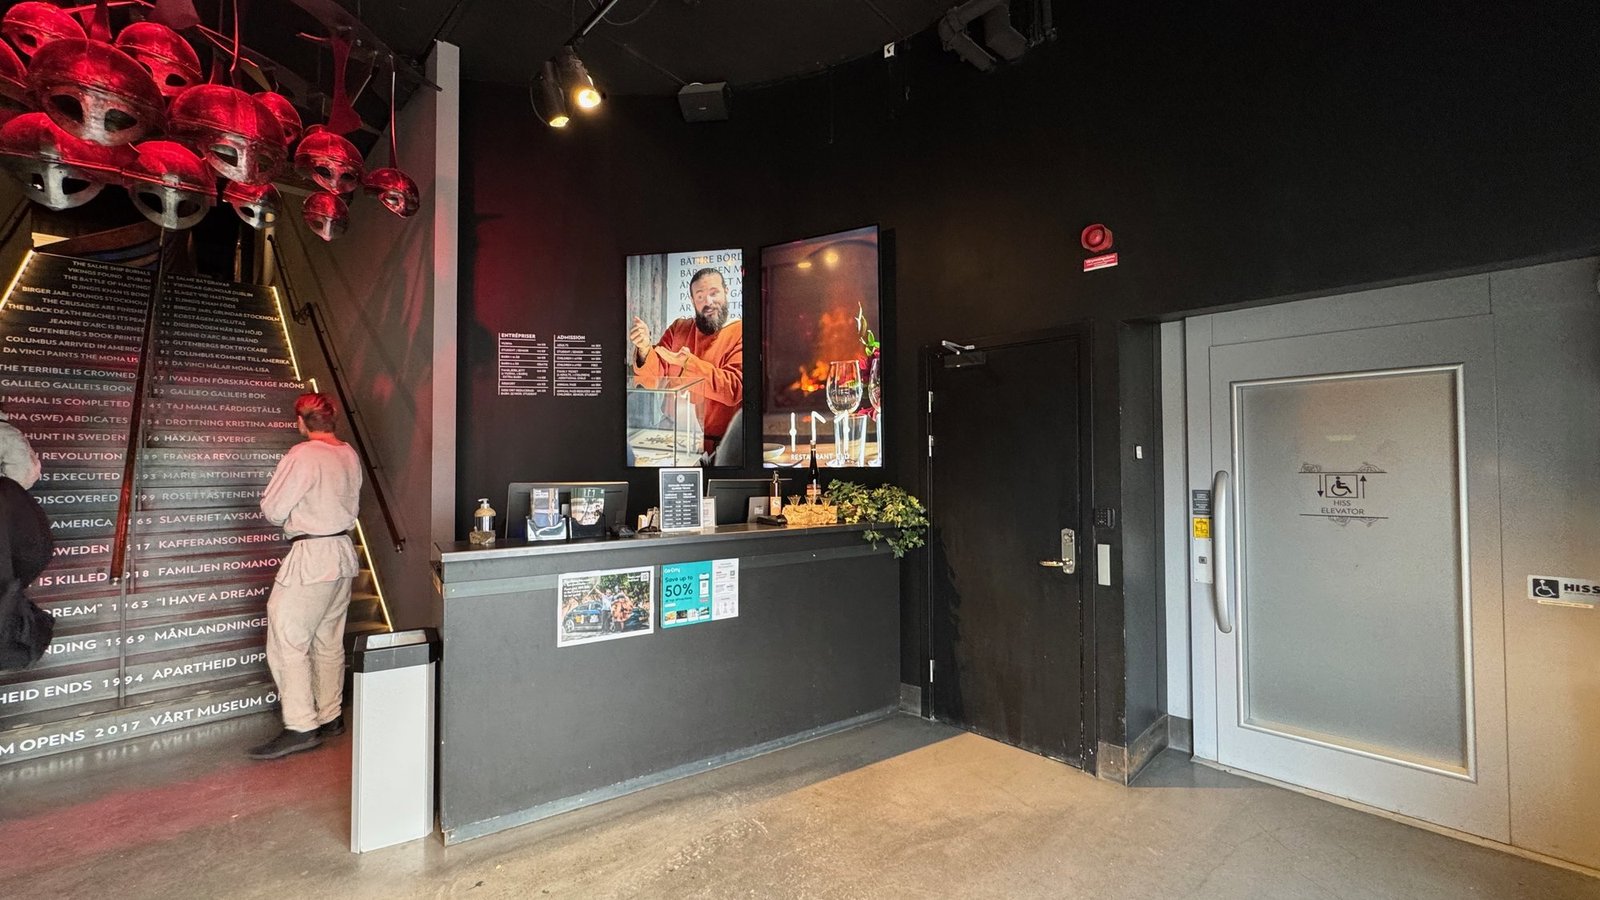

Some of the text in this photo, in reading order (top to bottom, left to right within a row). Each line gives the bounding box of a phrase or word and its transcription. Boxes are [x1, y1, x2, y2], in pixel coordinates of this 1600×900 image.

[60, 300, 100, 309] CRUSADES
[82, 312, 116, 320] REACHES
[5, 336, 57, 346] COLUMBUS
[174, 350, 214, 358] COLUMBUS
[28, 326, 87, 337] GUTENBERG'S
[173, 340, 219, 348] GUTENBERGS
[220, 344, 267, 353] BOKTRYCKARE
[1, 379, 50, 388] GALILEO
[21, 365, 70, 375] TERRIBLE
[84, 370, 136, 379] CROWNED
[212, 377, 277, 388] FÖRSKRÄCKLIGE
[279, 381, 304, 389] KRÖNS
[64, 398, 130, 408] COMPLETED
[30, 414, 63, 422] (SWE)
[66, 416, 128, 424] ABDICATES
[162, 492, 254, 500] ROSETTASTENEN
[50, 519, 113, 529] AMERICA
[159, 513, 221, 524] SLAVERIET
[159, 534, 280, 549] KAFFERANSONERING
[39, 577, 52, 586] IS
[56, 572, 108, 584] KILLED
[158, 563, 220, 576] FAMILJEN
[665, 583, 693, 597] 50%
[1564, 584, 1600, 594] HISS
[112, 600, 149, 611] 163
[169, 594, 205, 605] HAVE
[208, 592, 218, 601] A
[221, 587, 269, 600] DREAM"
[155, 618, 268, 641] MÅNLANDNINGE
[44, 680, 92, 697] ENDS
[102, 674, 144, 688] 1994
[152, 658, 236, 680] APARTHEID
[20, 730, 85, 751] OPENS
[95, 721, 140, 738] 2017
[150, 709, 194, 726] VÅRT
[198, 696, 262, 717] MUSEUM
